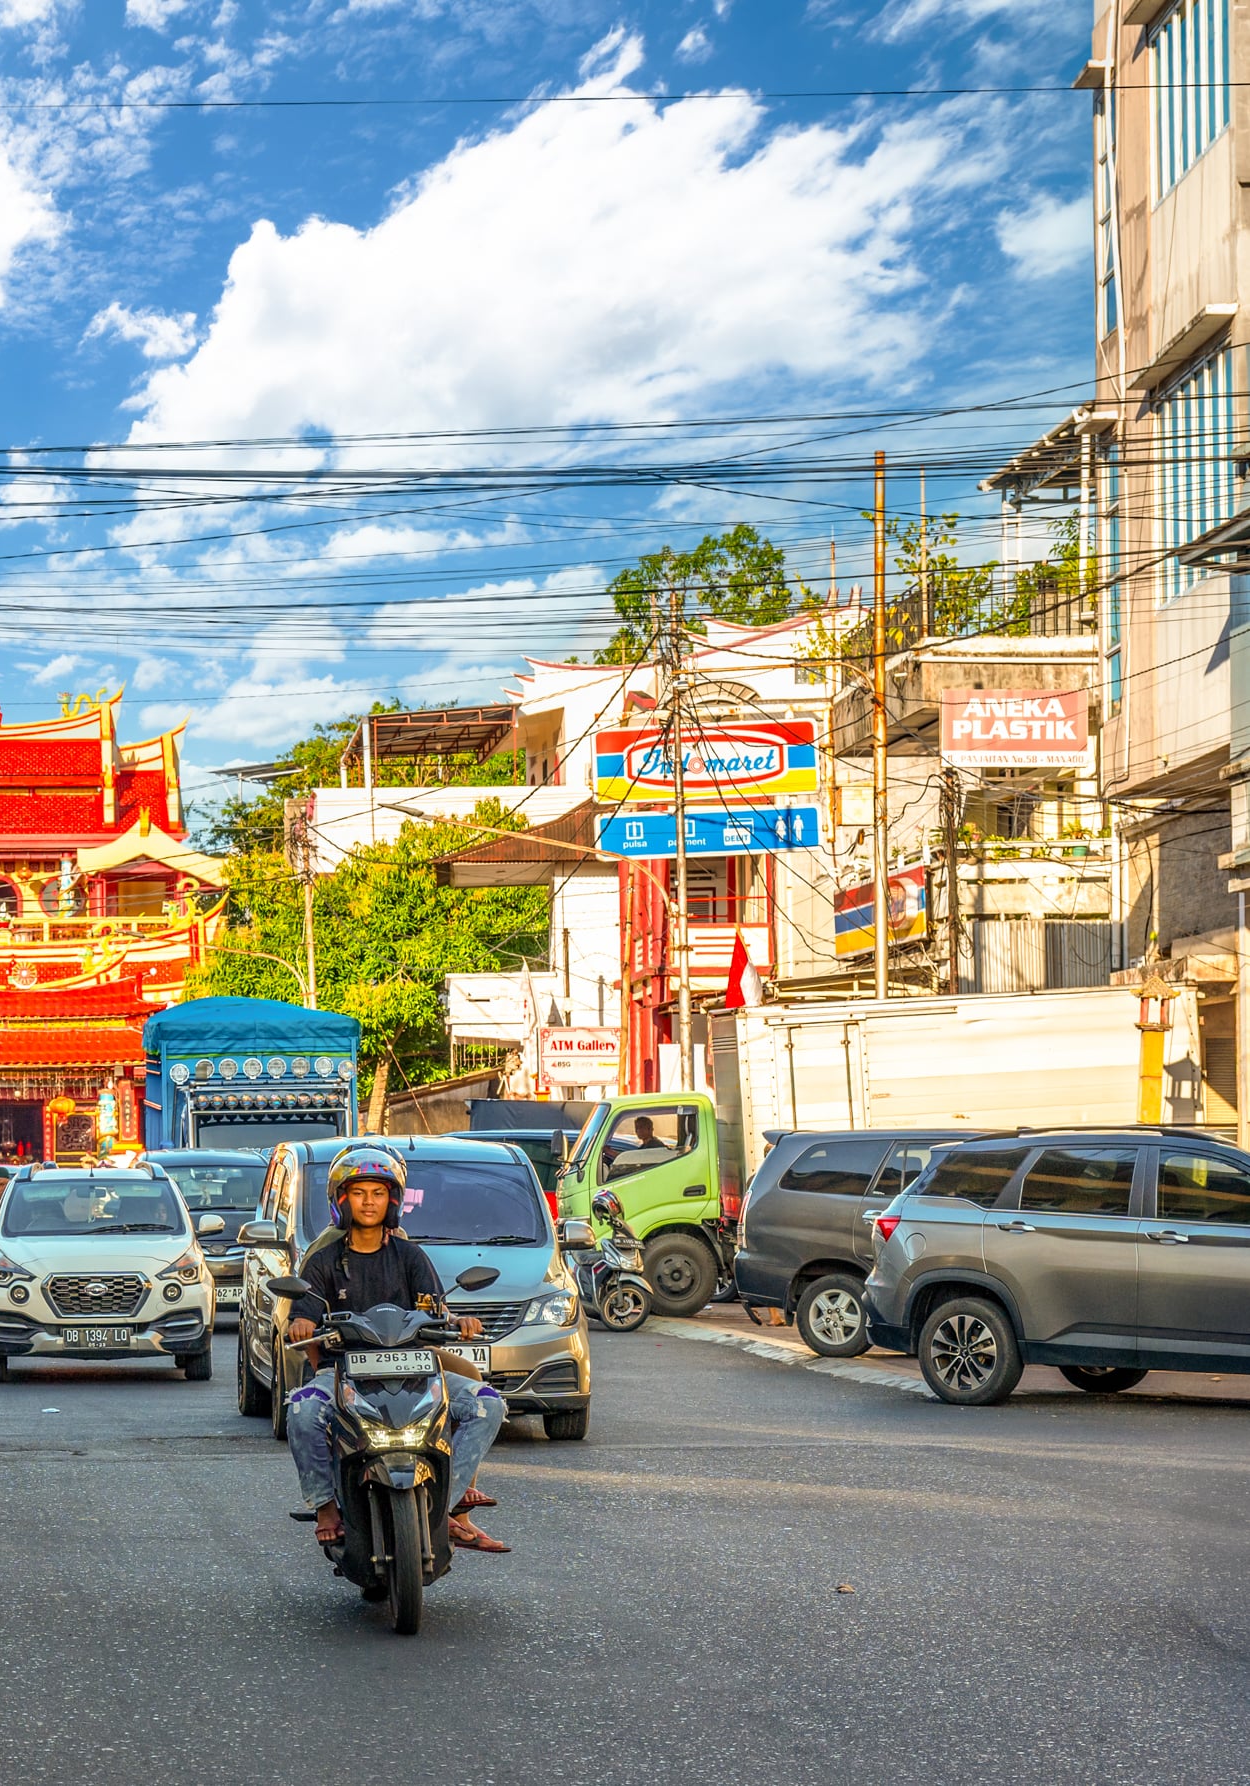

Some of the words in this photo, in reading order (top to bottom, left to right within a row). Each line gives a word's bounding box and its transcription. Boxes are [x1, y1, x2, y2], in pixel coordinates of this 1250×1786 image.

[962, 698, 1066, 718] ANEKA
[952, 720, 1077, 740] PLASTIK
[622, 840, 648, 849] pulsa
[550, 1040, 573, 1051] ATM
[577, 1039, 616, 1053] Gallery
[66, 1330, 79, 1342] DB
[85, 1330, 108, 1342] 1394
[351, 1354, 367, 1364] DB
[376, 1353, 408, 1362] 2963
[414, 1352, 431, 1361] RX
[472, 1348, 486, 1361] YA
